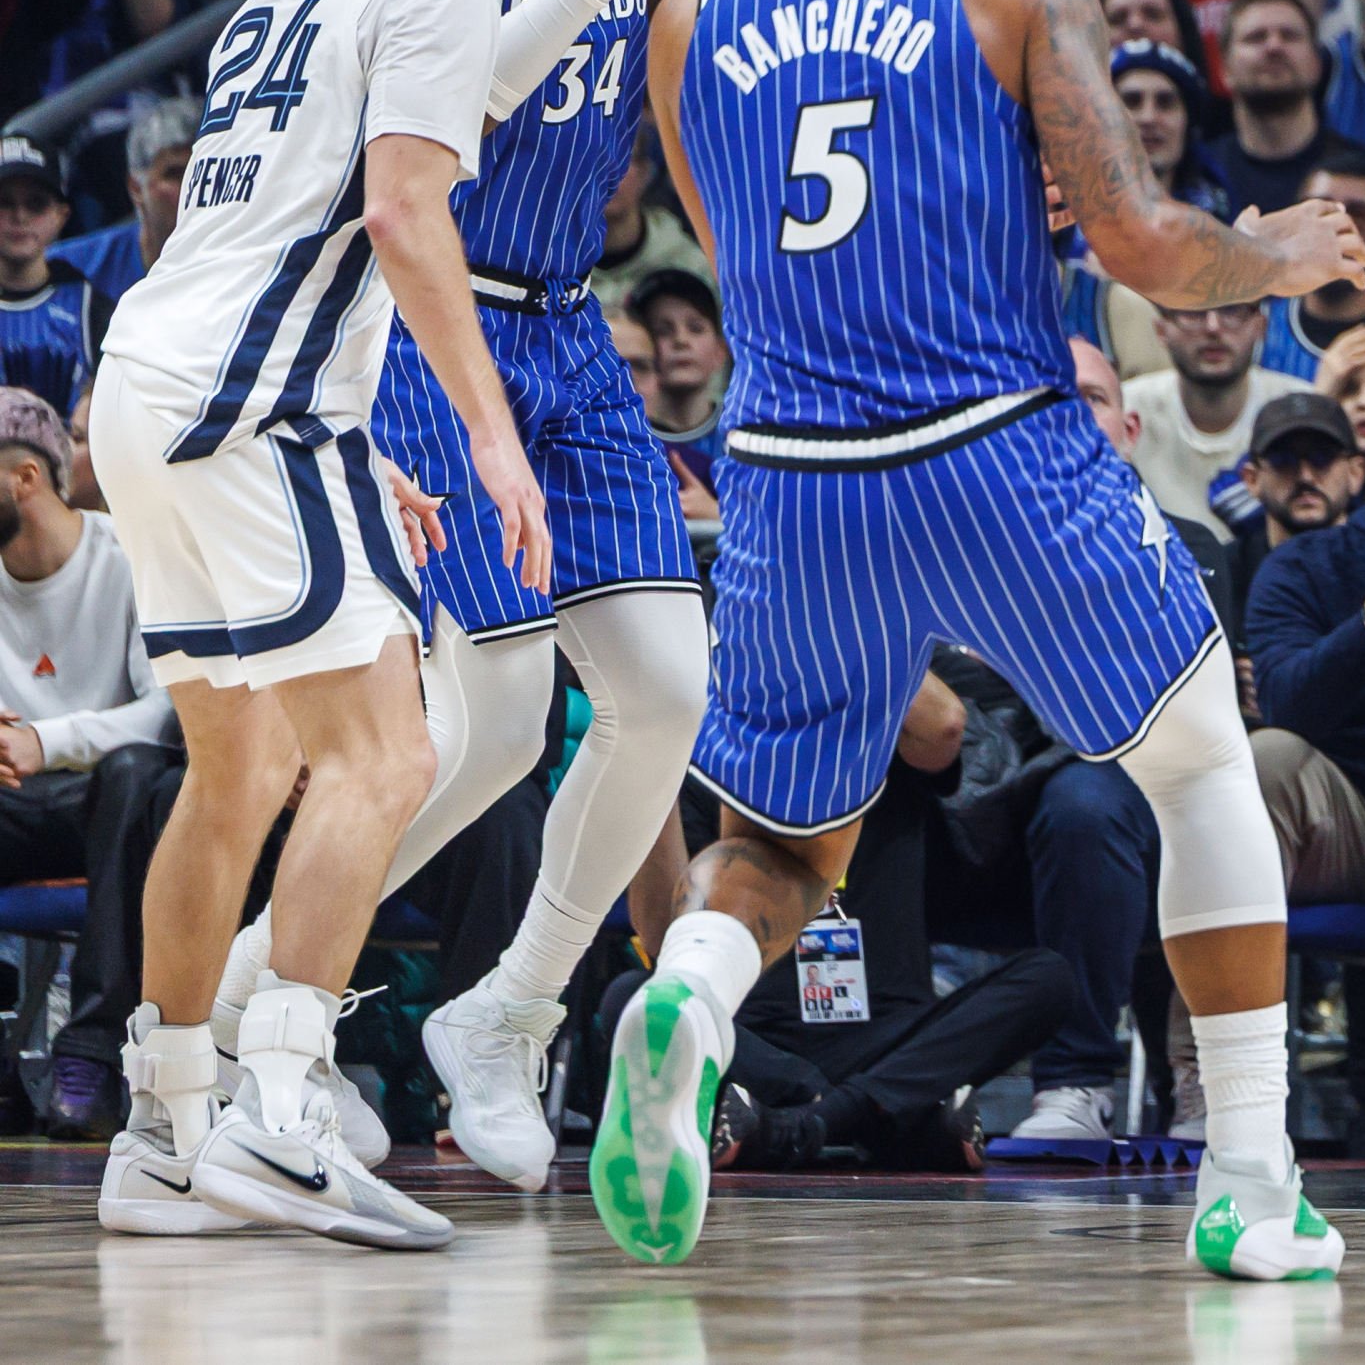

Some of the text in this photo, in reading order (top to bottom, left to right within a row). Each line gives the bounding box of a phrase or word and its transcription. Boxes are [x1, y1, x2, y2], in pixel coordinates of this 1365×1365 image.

[541, 38, 628, 124] 34
[184, 153, 262, 212] SPENCER
[777, 95, 879, 255] 5
